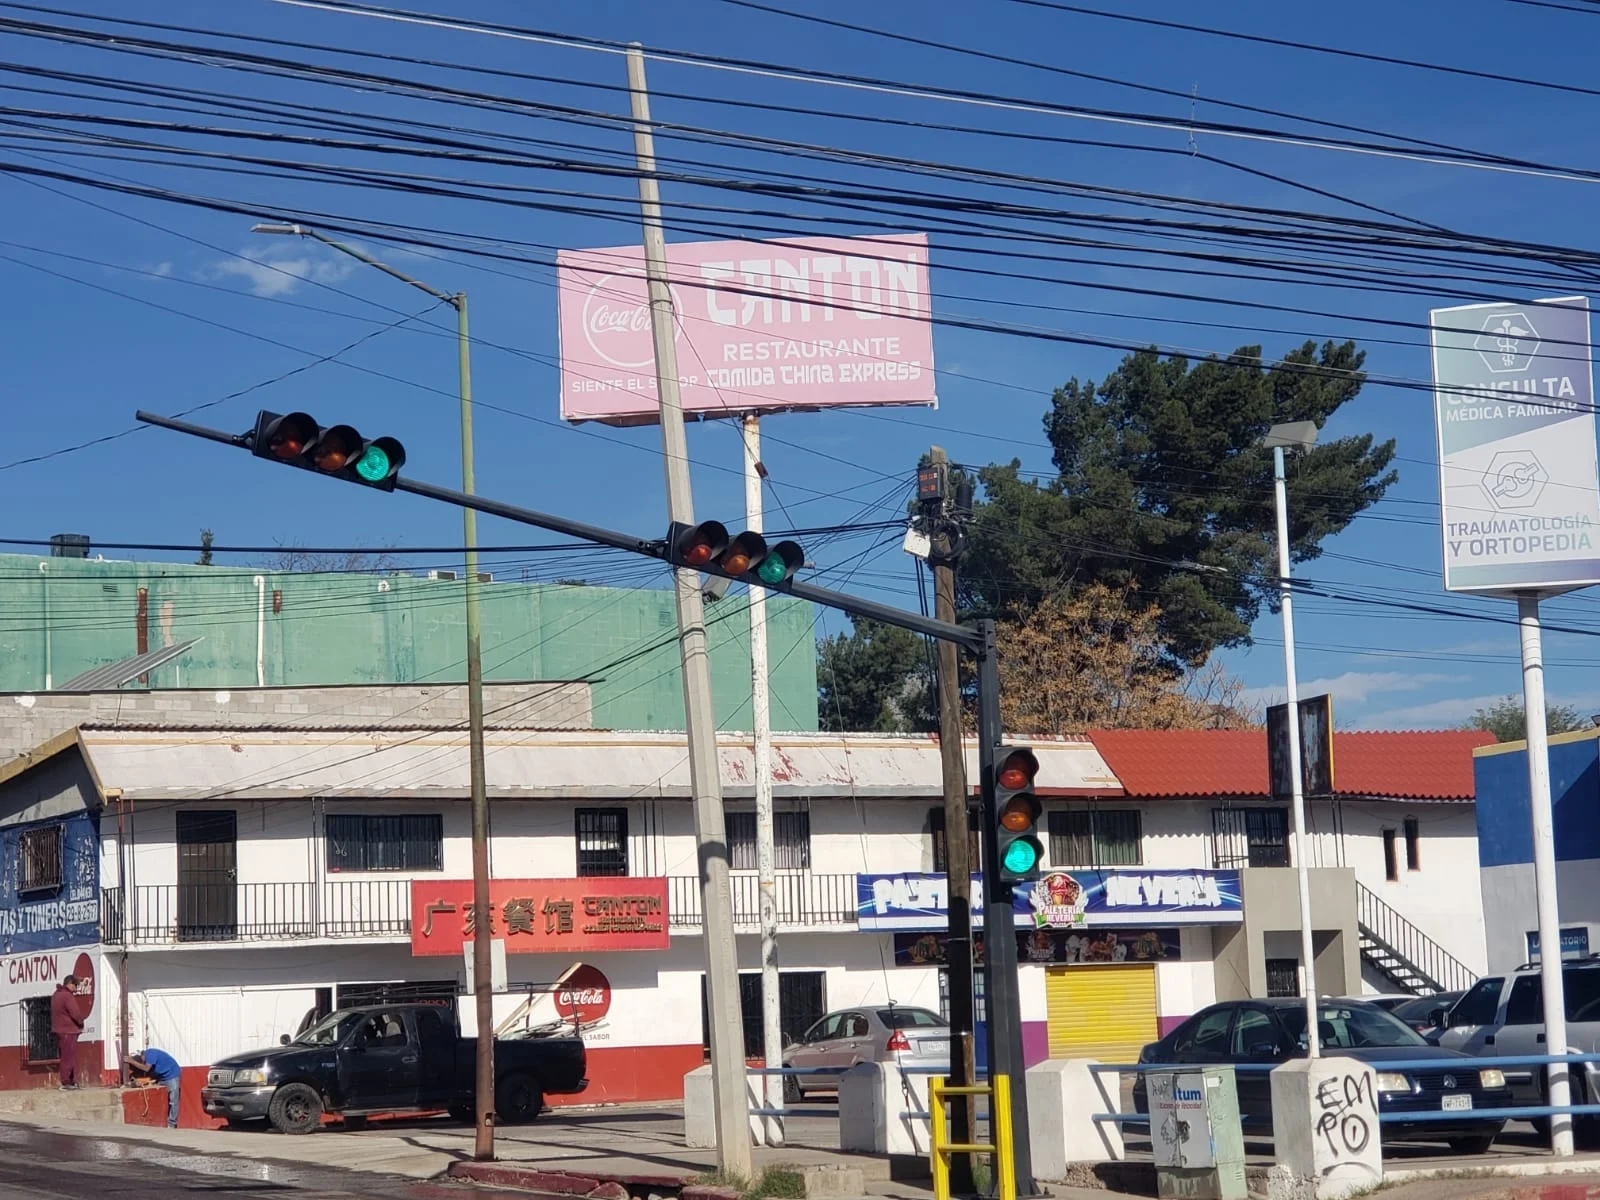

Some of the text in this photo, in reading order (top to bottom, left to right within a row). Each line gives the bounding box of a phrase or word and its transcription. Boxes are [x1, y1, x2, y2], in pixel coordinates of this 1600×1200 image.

[700, 253, 920, 327] CANTON
[590, 304, 653, 333] Coca-Co
[723, 337, 901, 361] RESTAURANTE
[572, 375, 698, 393] SIENTE EL SOR
[1446, 376, 1575, 405] CONSULTA
[1446, 401, 1579, 422] MÉDICA FAMILIAR
[1448, 511, 1592, 537] TRAUMATOLOGÍA
[1450, 532, 1592, 557] Y ORTOPEDIA
[25, 901, 66, 933] TONERS
[582, 895, 662, 915] CANTON
[9, 955, 58, 984] CANTON
